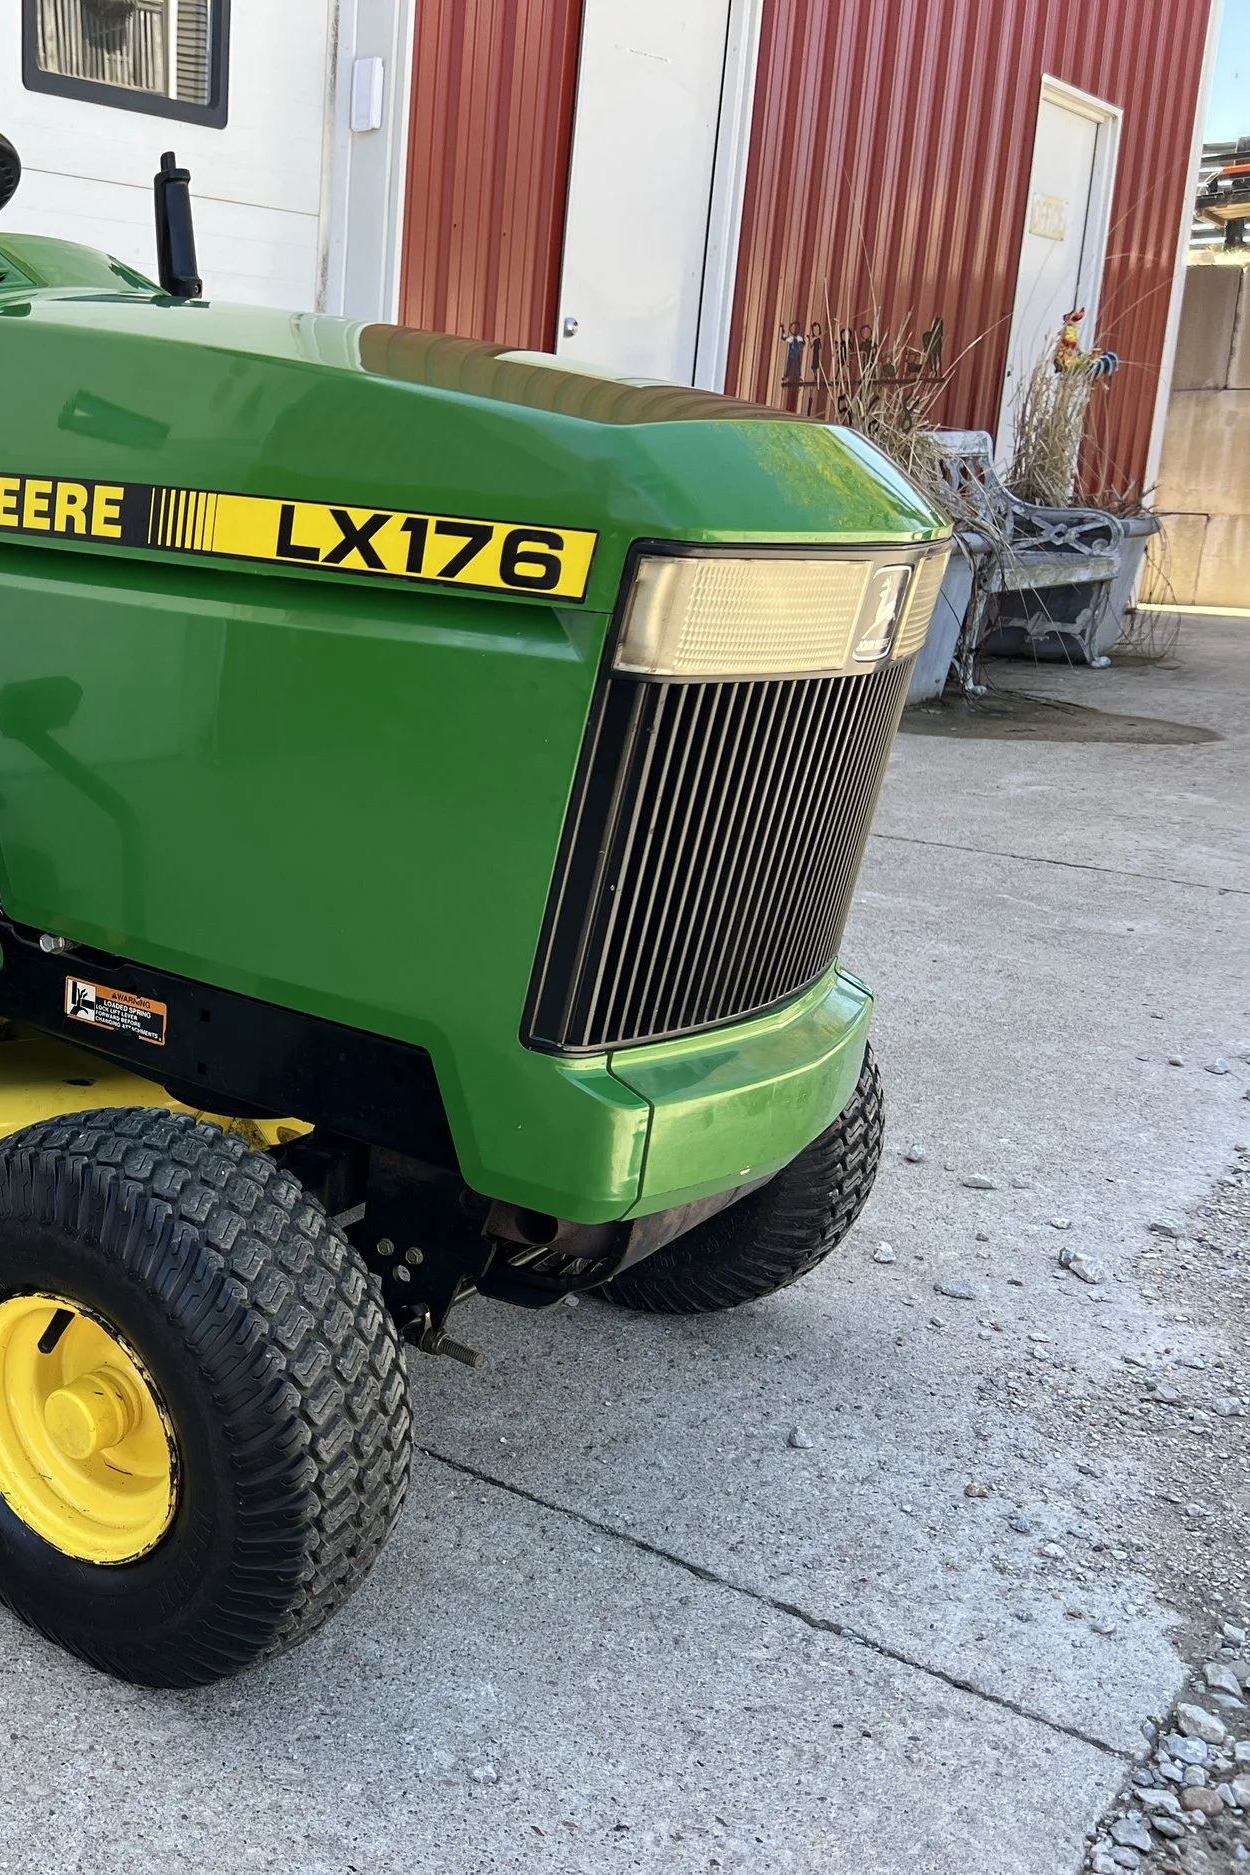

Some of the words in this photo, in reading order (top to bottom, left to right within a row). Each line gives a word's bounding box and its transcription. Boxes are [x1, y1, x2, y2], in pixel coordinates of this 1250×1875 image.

[276, 503, 564, 590] LX176
[116, 992, 150, 1008] WARNING
[95, 1004, 109, 1012] LOCK
[121, 1011, 138, 1021] LEVER
[103, 1000, 128, 1012] LOADED
[129, 1006, 151, 1019] SPRING
[95, 1010, 120, 1022] FORWARD
[121, 1017, 141, 1028] BEFORE
[95, 1015, 121, 1027] CHANGING
